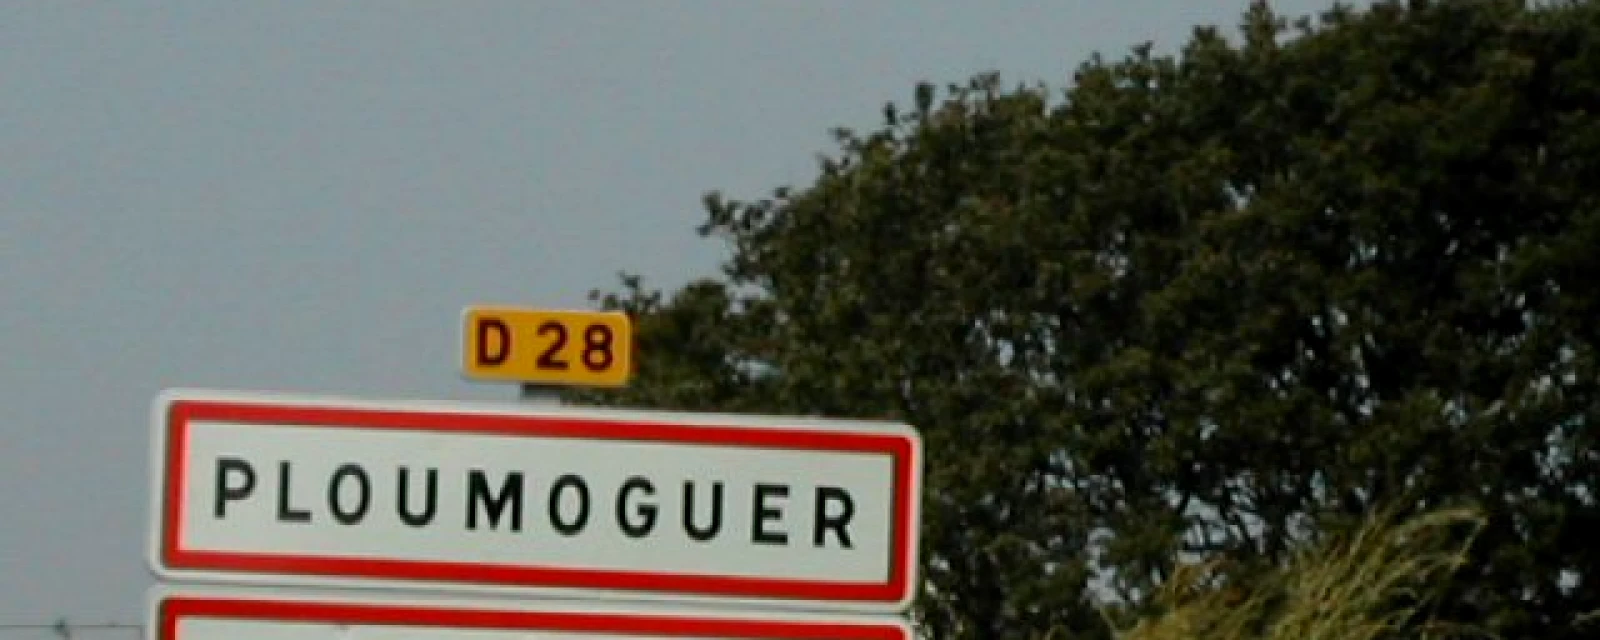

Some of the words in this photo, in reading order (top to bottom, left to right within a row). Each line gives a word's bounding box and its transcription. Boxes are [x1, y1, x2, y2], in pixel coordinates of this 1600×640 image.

[476, 316, 512, 368] D
[534, 319, 615, 373] 28
[213, 457, 857, 550] PLOUMOGUER
